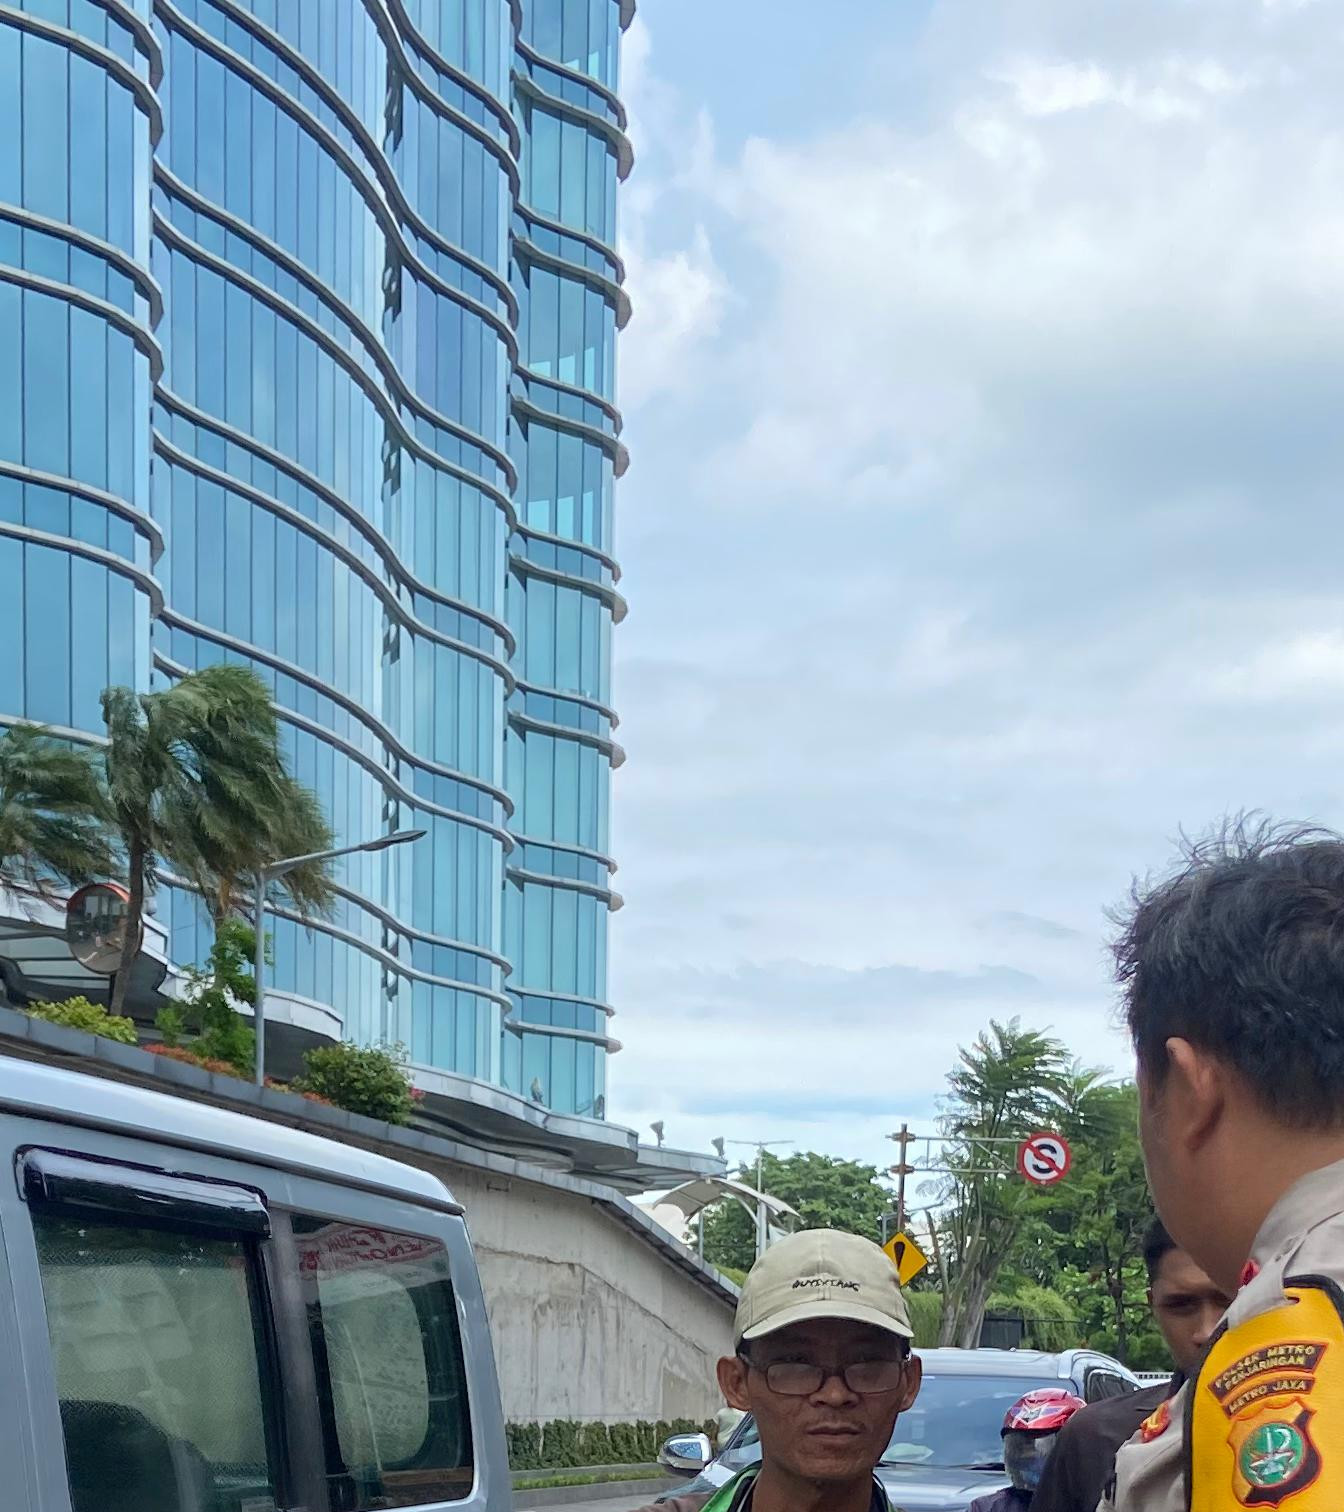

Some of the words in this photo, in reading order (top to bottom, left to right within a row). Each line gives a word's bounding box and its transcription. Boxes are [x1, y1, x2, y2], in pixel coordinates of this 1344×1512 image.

[1266, 1344, 1316, 1357] METRO
[1224, 1355, 1306, 1391] PENJARINGAN
[1228, 1384, 1268, 1414] METRO
[1272, 1378, 1306, 1392] JAYA
